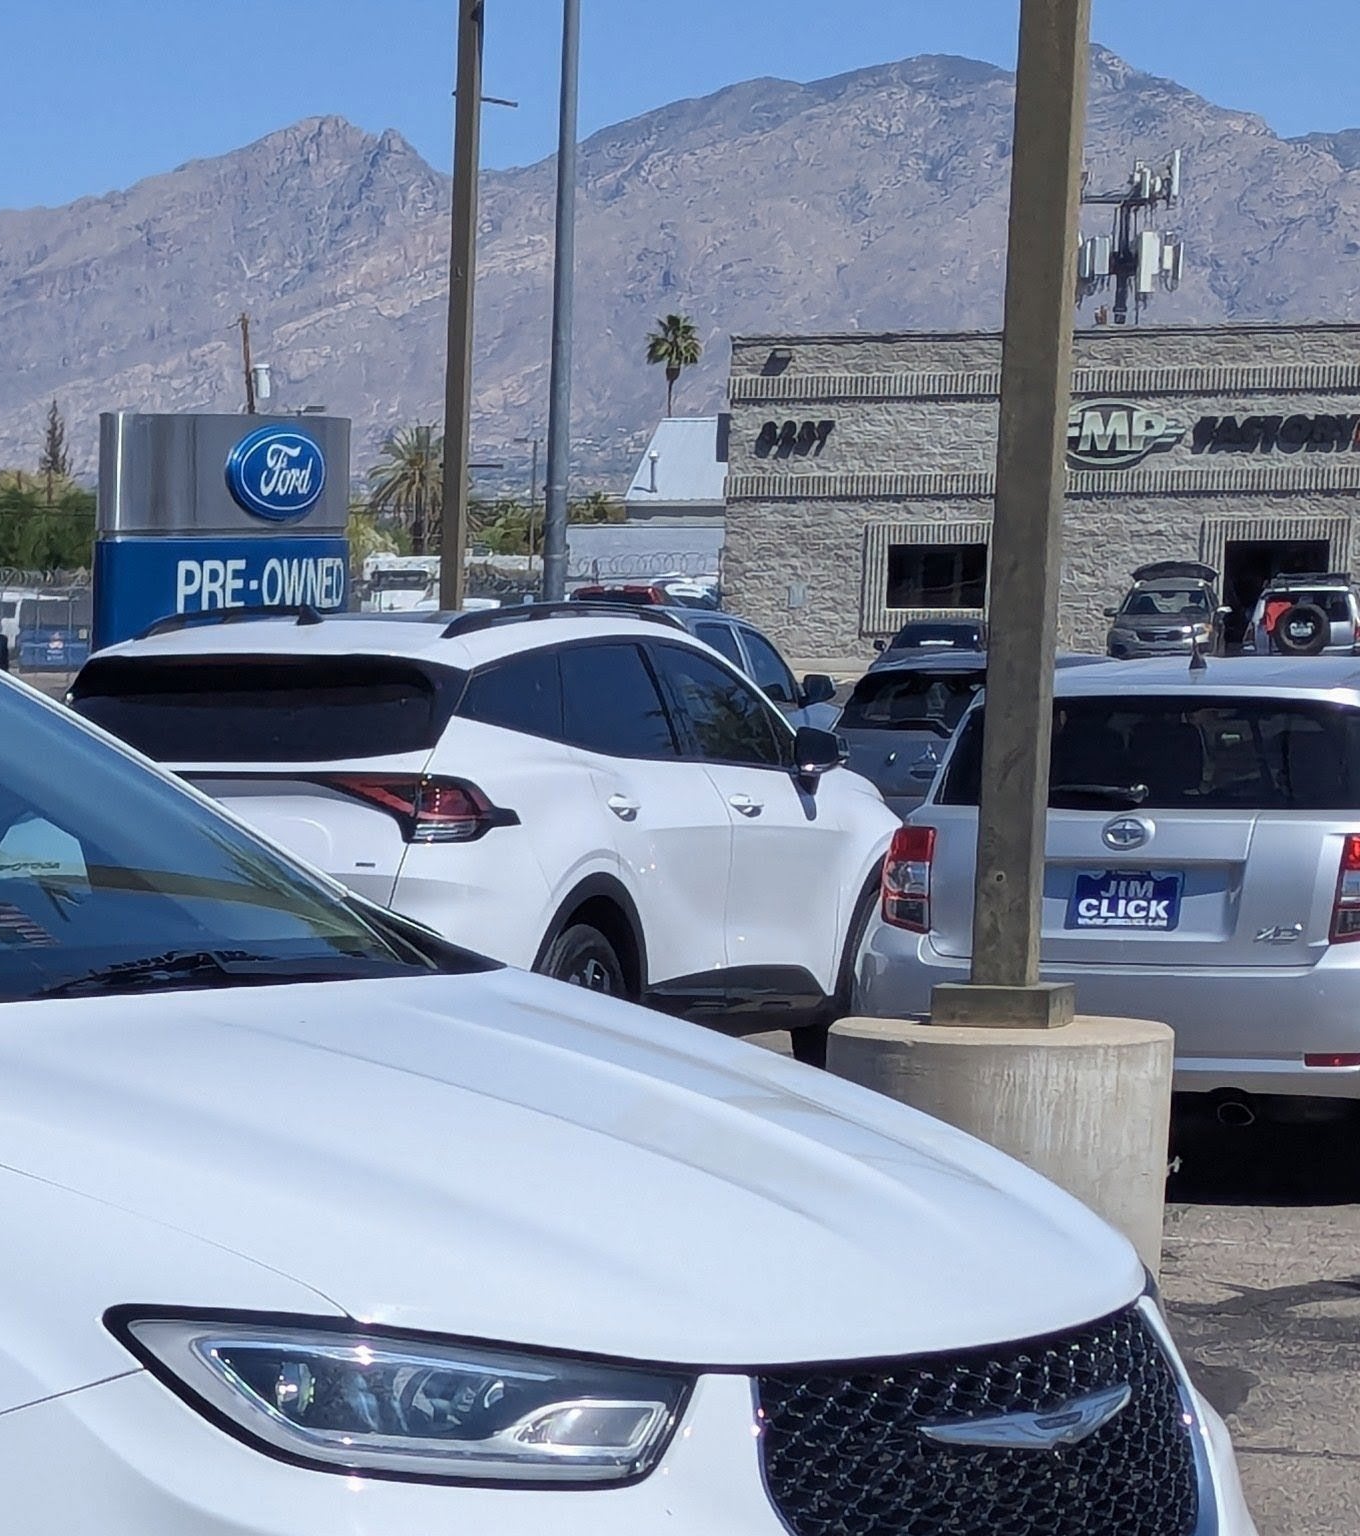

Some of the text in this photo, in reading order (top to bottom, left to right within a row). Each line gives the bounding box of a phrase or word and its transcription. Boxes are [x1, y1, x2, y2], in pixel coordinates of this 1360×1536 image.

[1068, 410, 1165, 451] MP
[260, 443, 312, 496] Ford
[176, 557, 345, 614] PRE-OWNED
[1078, 898, 1170, 919] CLICK
[1100, 880, 1155, 899] JIM
